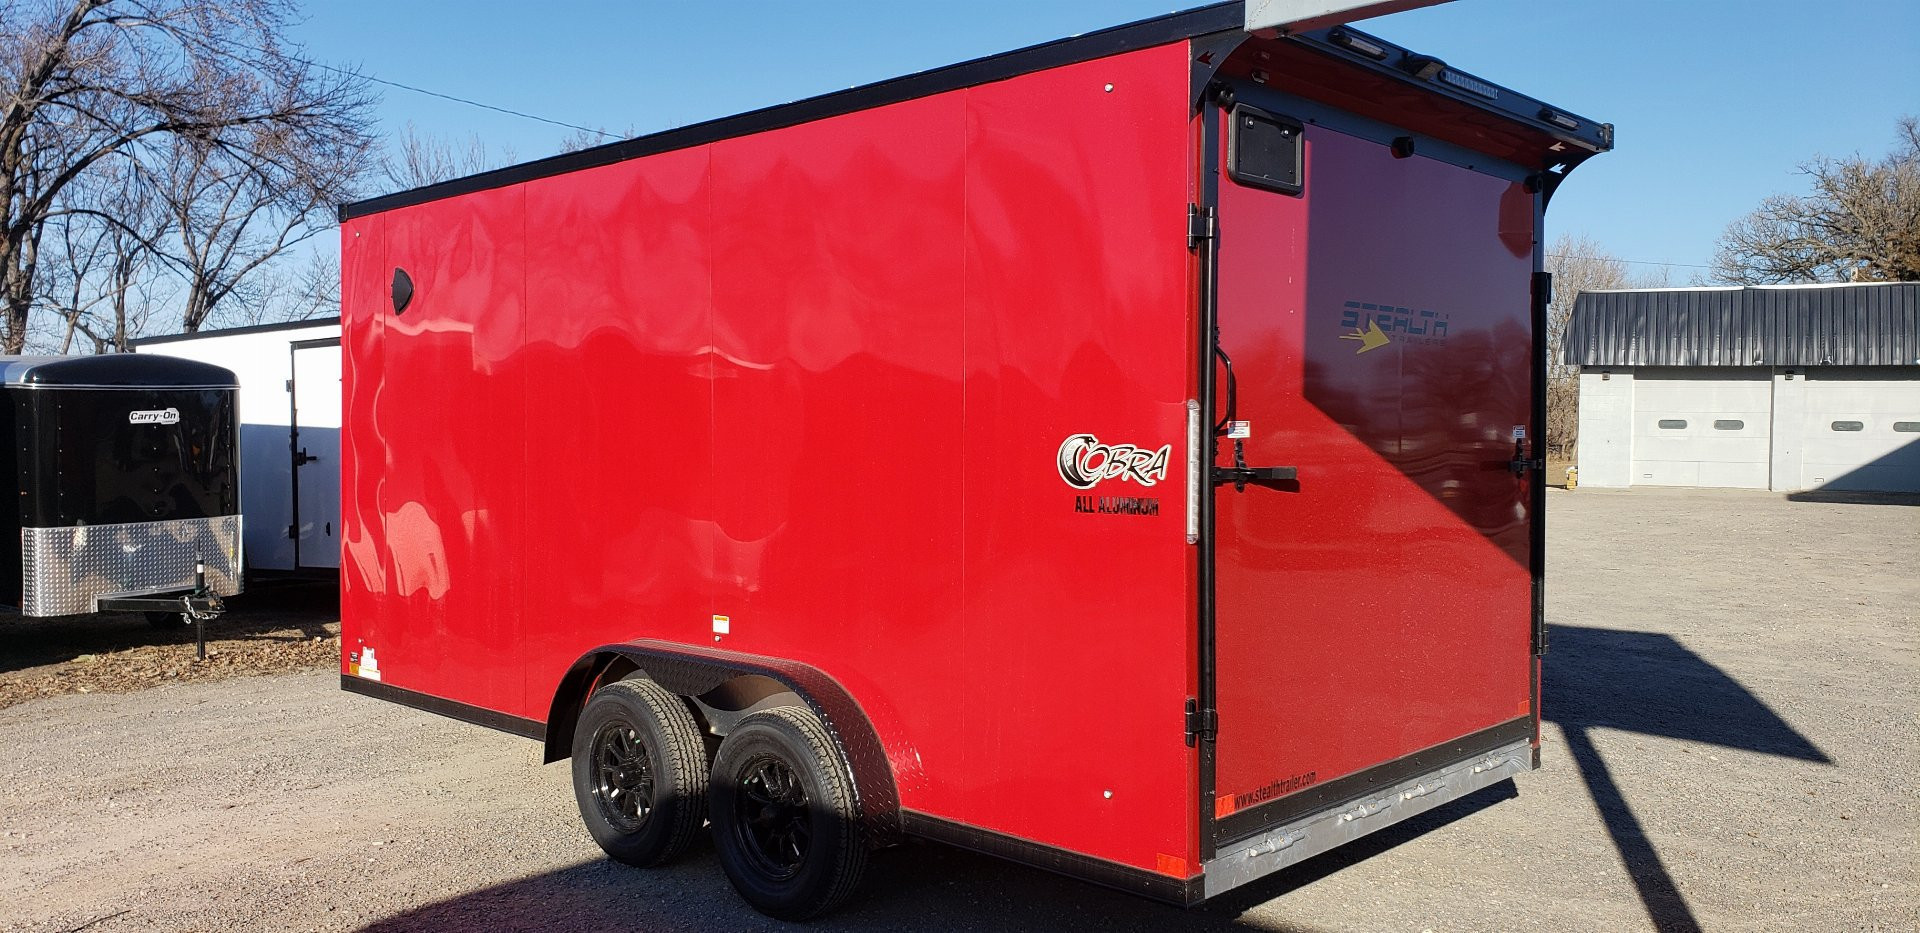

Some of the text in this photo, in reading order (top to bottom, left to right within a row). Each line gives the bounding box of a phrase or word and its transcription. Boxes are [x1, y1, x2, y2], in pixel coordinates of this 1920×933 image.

[1341, 301, 1449, 337] STEALTH
[130, 411, 176, 421] Carry-On
[1058, 434, 1171, 488] COBRA
[1075, 495, 1159, 516] ALL ALUMINUM
[1234, 771, 1317, 809] www.stealthtrailer.com
